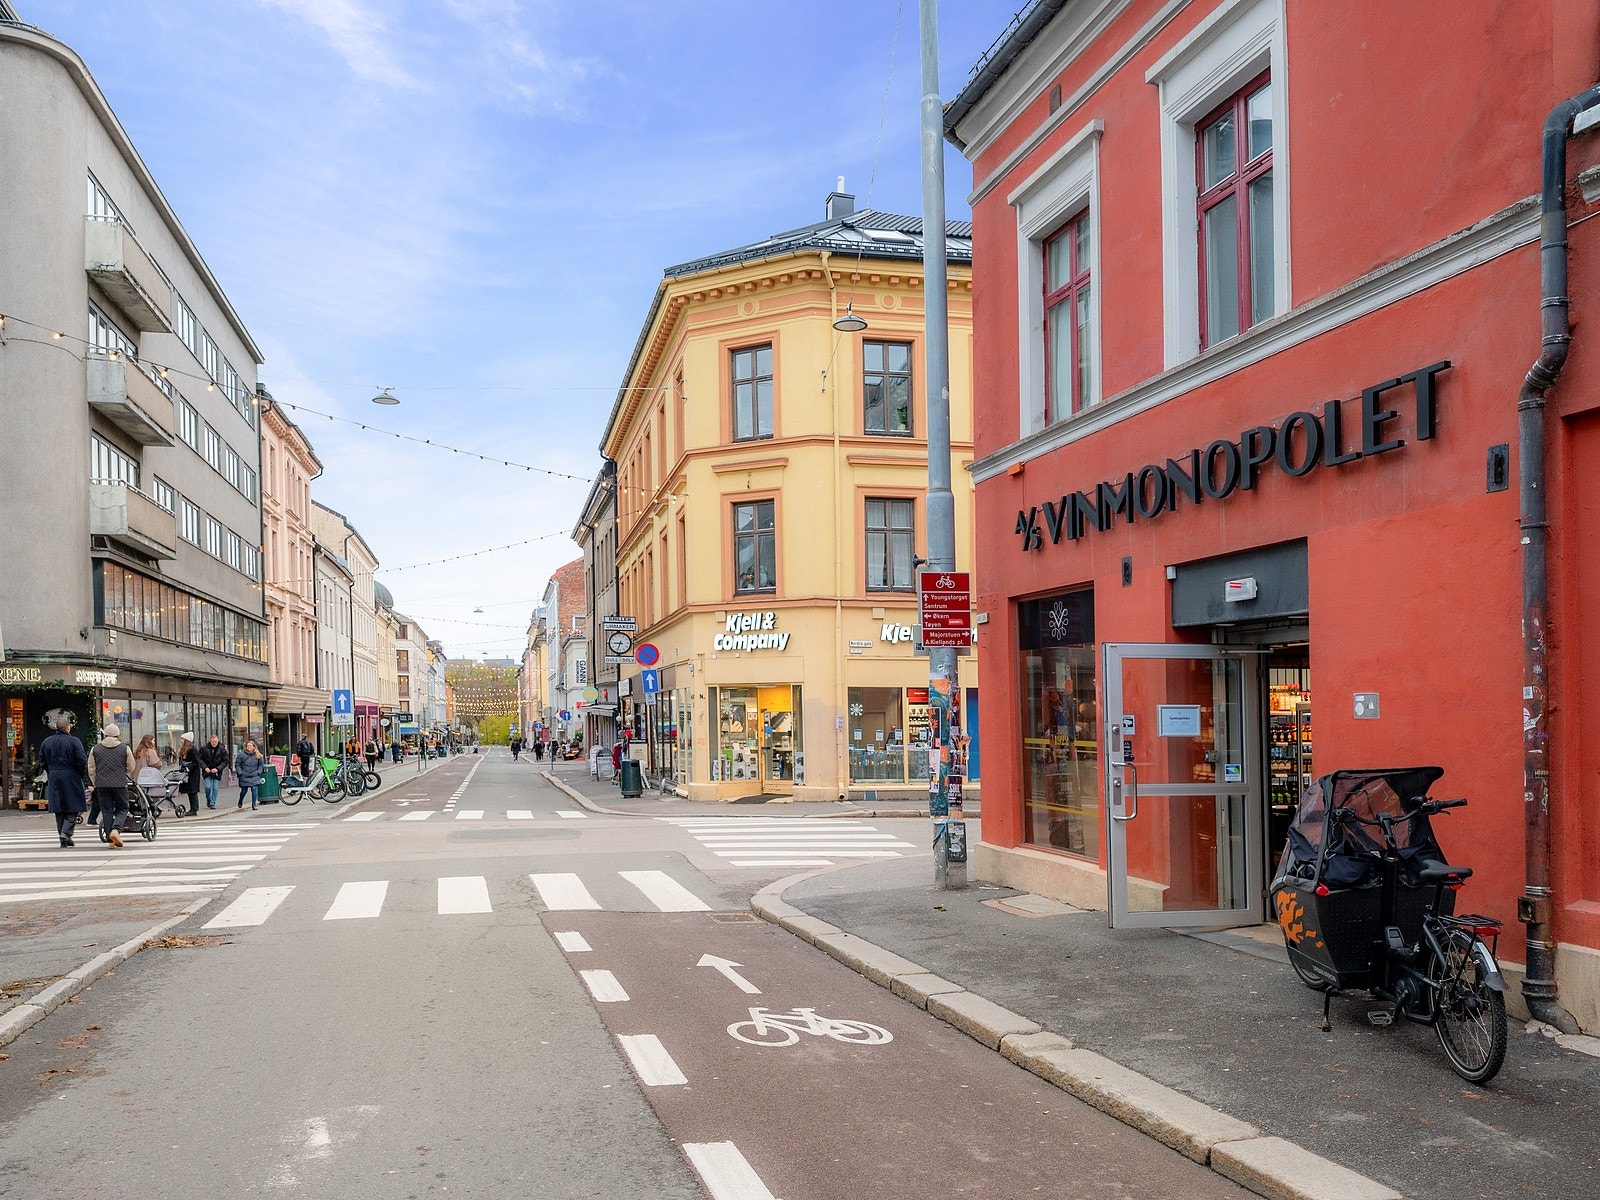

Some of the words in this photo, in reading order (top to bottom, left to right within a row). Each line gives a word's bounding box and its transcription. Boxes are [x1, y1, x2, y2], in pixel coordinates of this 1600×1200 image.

[1042, 360, 1452, 545] VINMONOPOLET
[930, 594, 967, 602] Youngstorget
[725, 612, 763, 635] Kjell
[761, 611, 776, 630] &
[713, 632, 791, 653] Company
[929, 631, 961, 639] Majorstuen
